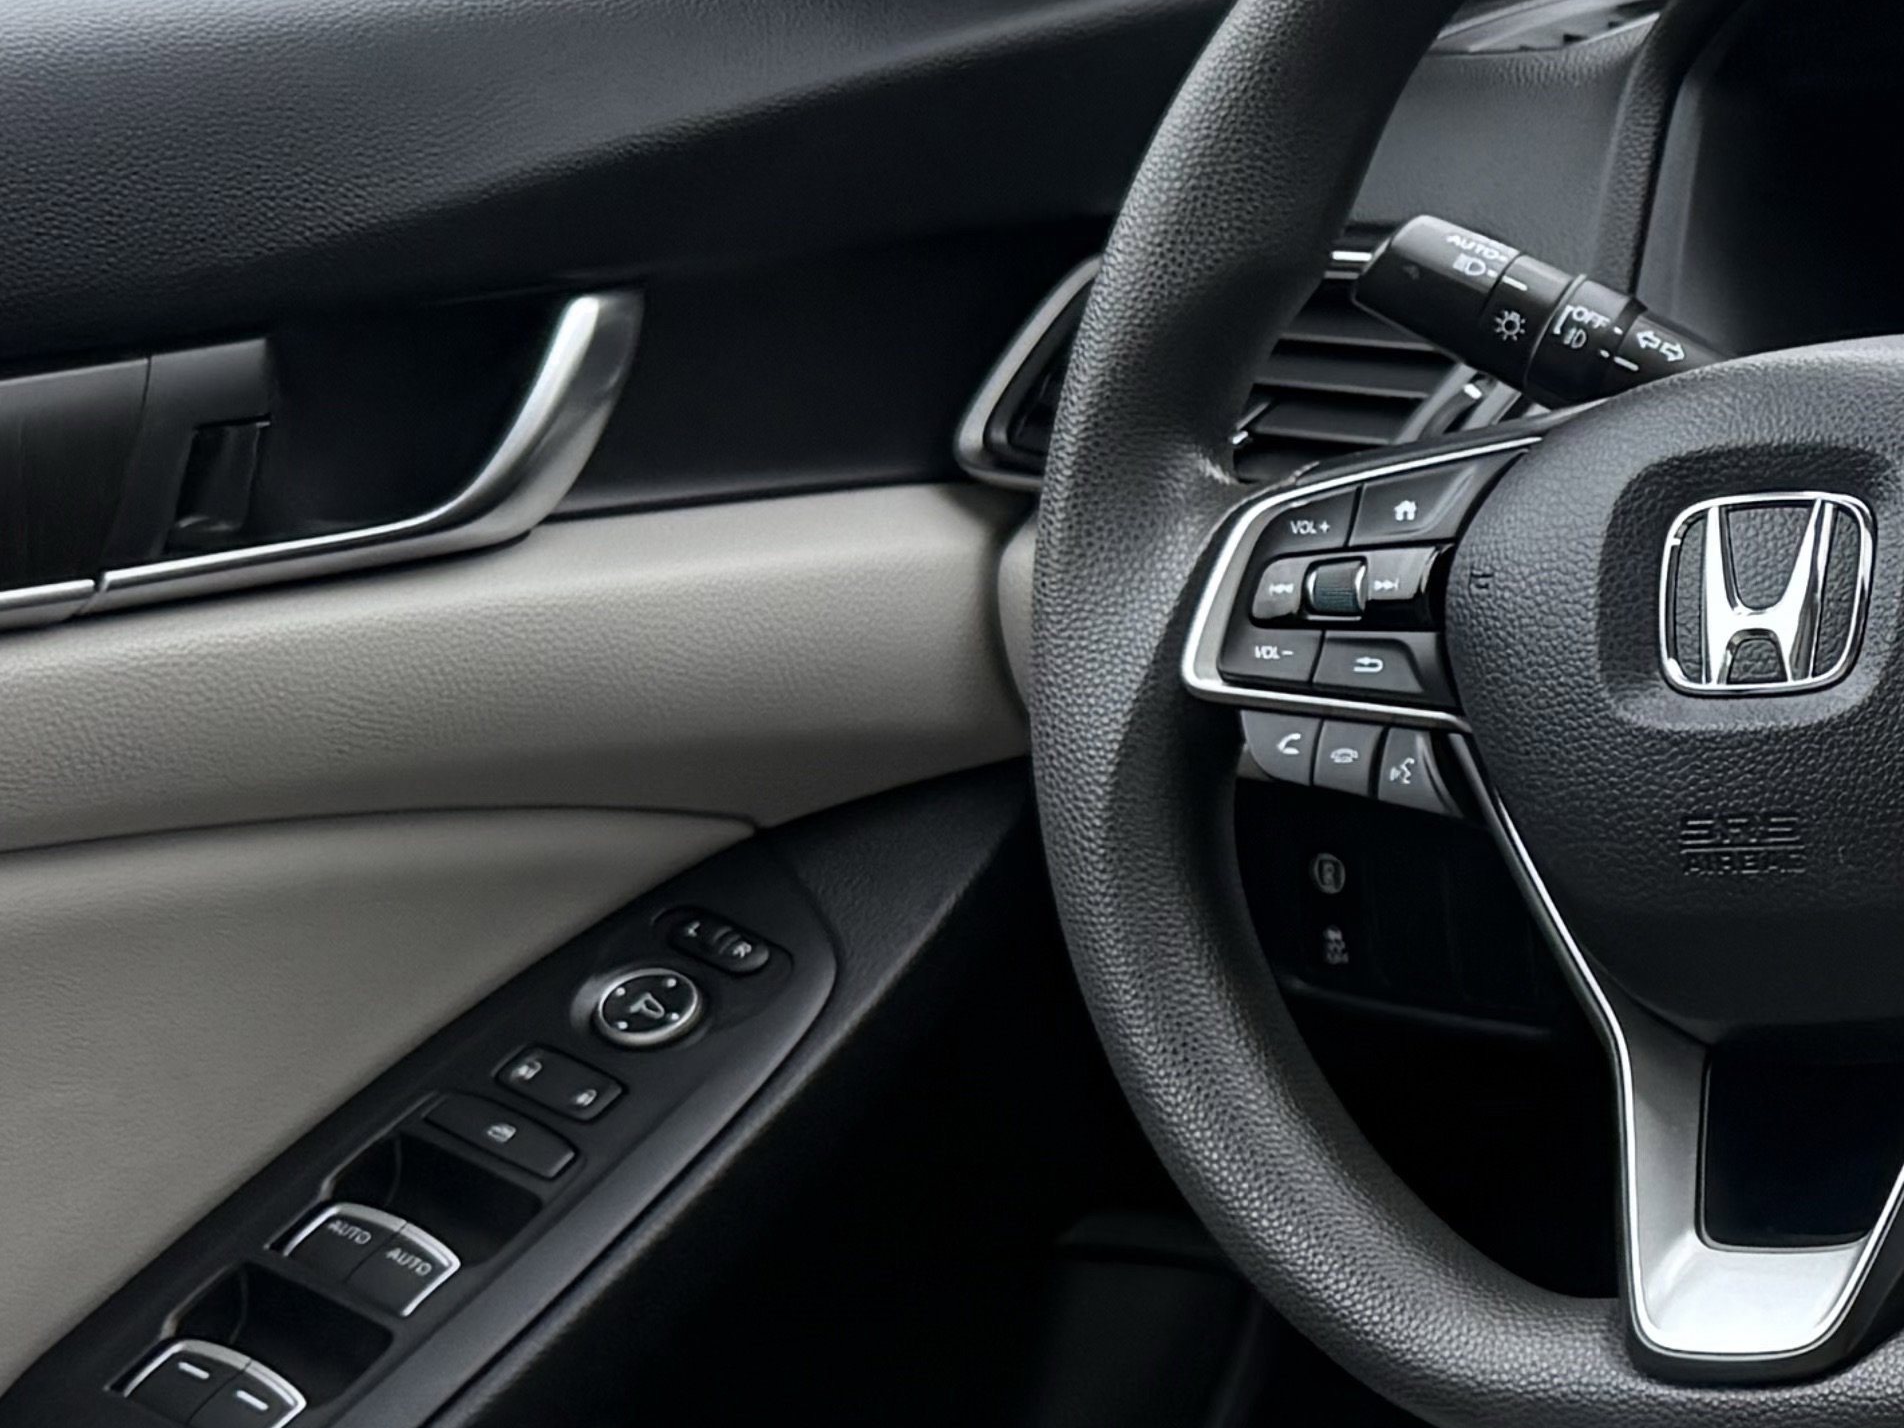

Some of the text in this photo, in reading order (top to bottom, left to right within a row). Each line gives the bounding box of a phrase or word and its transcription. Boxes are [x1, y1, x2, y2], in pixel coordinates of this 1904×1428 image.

[1446, 233, 1502, 262] AUTO
[1572, 306, 1610, 329] OFF
[327, 1217, 373, 1245] AUTO
[386, 1246, 433, 1278] AUTO
